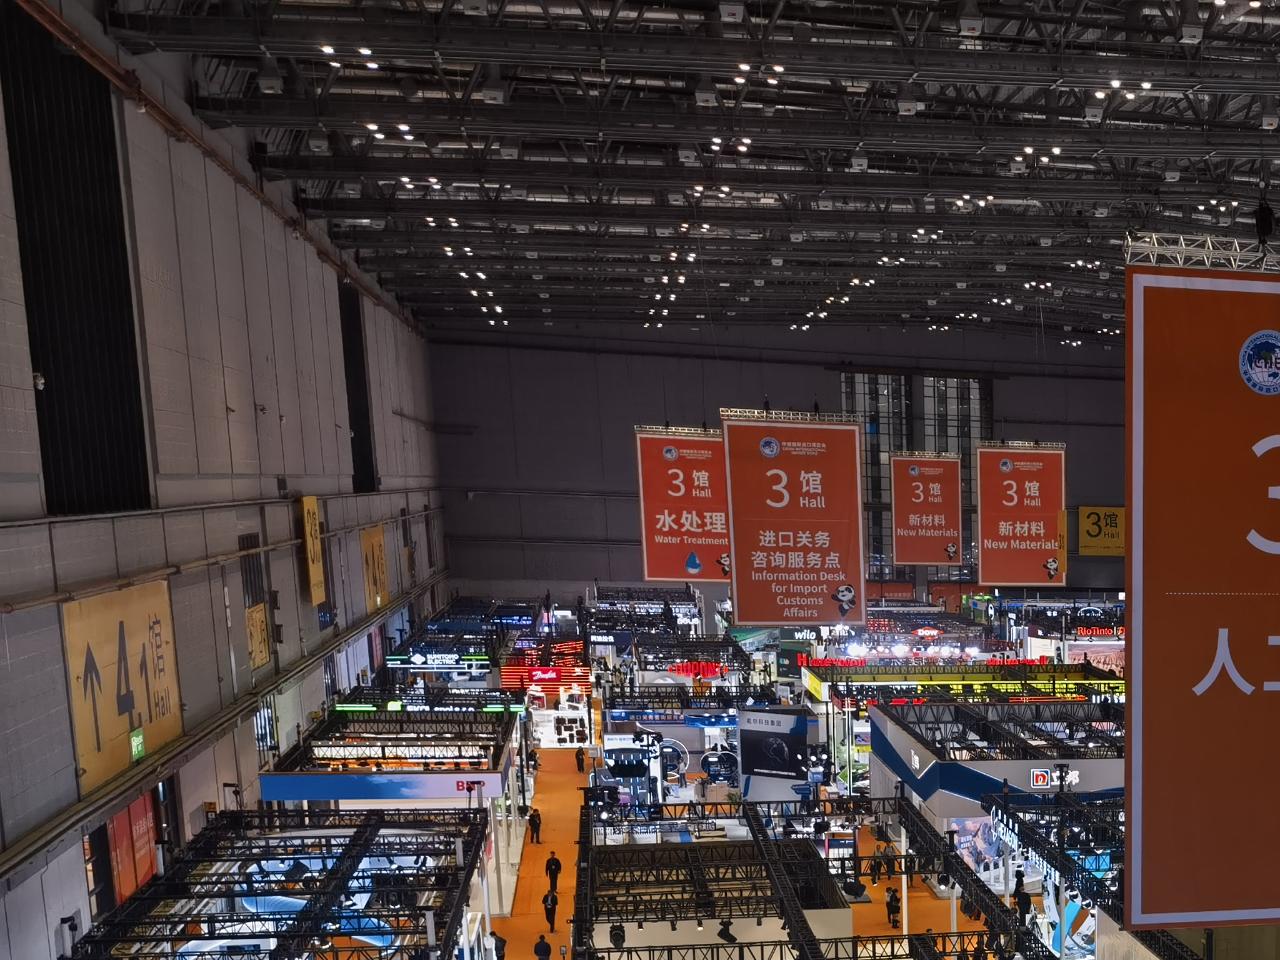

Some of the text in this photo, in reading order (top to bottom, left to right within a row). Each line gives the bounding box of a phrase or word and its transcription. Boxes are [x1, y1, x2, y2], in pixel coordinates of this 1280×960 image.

[667, 468, 685, 497] 3
[692, 470, 709, 487] 馆
[800, 470, 822, 494] 馆
[692, 488, 712, 498] Hall
[766, 468, 790, 508] 3
[911, 482, 924, 503] 3
[929, 483, 941, 495] 馆
[1002, 480, 1018, 506] 3
[1024, 481, 1040, 497] 馆
[800, 496, 825, 508] Hall
[1024, 498, 1040, 507] Hall
[656, 510, 727, 533] 水处理
[909, 515, 945, 527] 新材料
[1086, 512, 1102, 538] 3
[1104, 512, 1118, 529] 馆
[897, 528, 958, 538] New Materials
[999, 521, 1045, 537] 新材料
[1104, 530, 1119, 539] Hall
[655, 535, 728, 546] Water Treatment
[759, 530, 831, 548] 进口关务
[984, 539, 1059, 550] New Materials
[751, 552, 841, 569] 咨询服务点
[751, 571, 846, 581] Information Desk
[772, 583, 828, 595] for Import
[777, 596, 823, 606] Customs
[783, 608, 818, 618] Affairs
[794, 631, 816, 640] wilo
